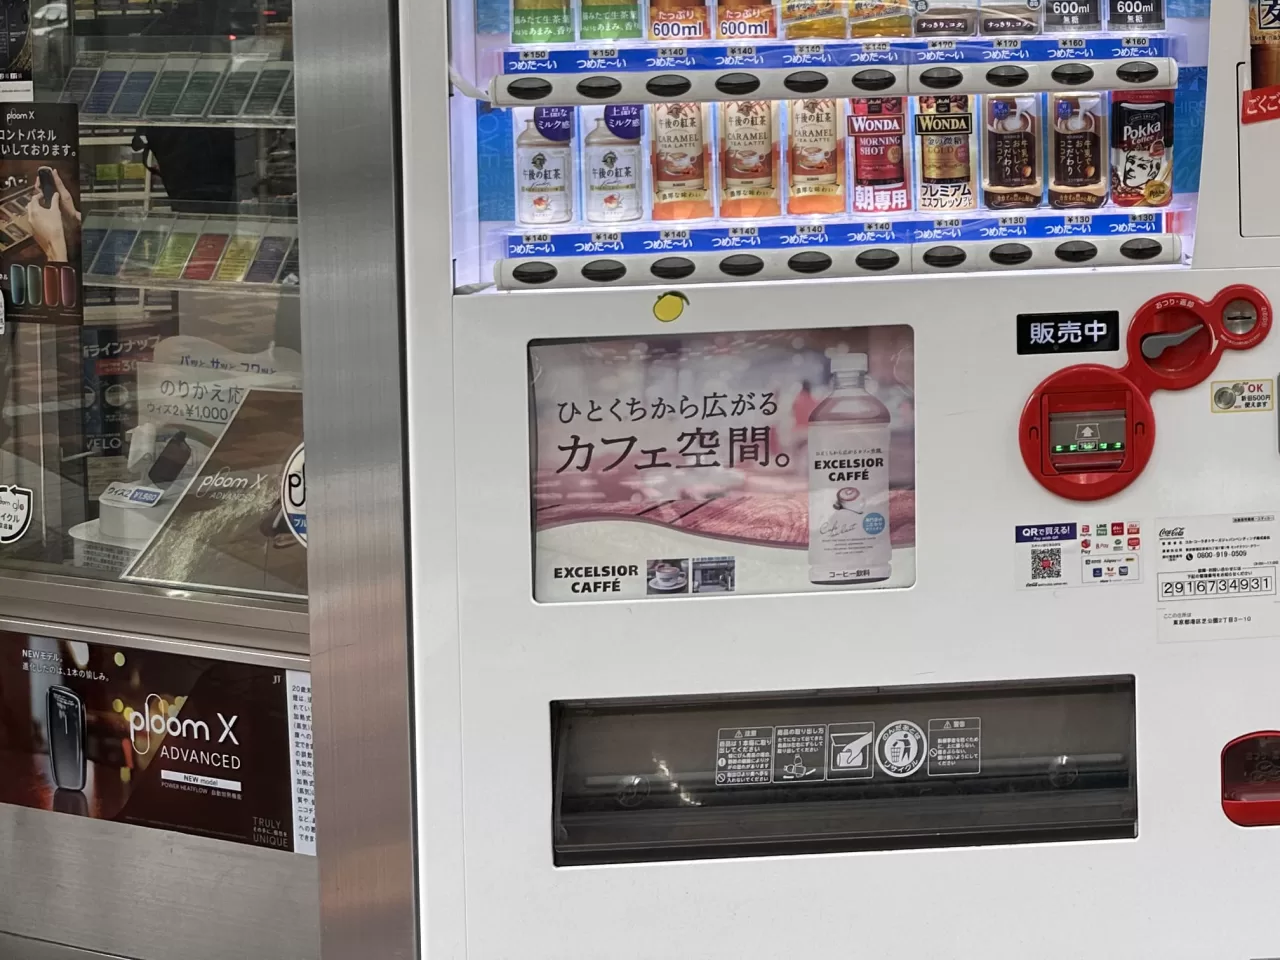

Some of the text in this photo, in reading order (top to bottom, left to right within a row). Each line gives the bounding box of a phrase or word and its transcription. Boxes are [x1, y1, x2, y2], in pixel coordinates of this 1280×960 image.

[658, 8, 694, 20] たっぷり
[725, 8, 761, 19] たっぷり
[1126, 14, 1144, 23] 無糖
[653, 21, 703, 37] 600ml
[720, 20, 769, 36] 600ml
[1125, 38, 1146, 46] ¥160
[523, 51, 546, 59] ¥150
[592, 49, 616, 57] ¥150
[540, 107, 567, 118] 上品な
[538, 119, 570, 130] ミルク感
[608, 118, 640, 129] ミルク感
[851, 116, 900, 132] WONDA
[919, 116, 968, 132] WONDA
[657, 133, 699, 143] CARAMEL
[1123, 121, 1161, 141] Pokka
[859, 136, 900, 146] MORNING
[859, 145, 884, 155] SHOT
[522, 169, 561, 181] 午後の紅茶
[922, 184, 972, 198] プレミアム
[855, 188, 907, 211] 朝専用
[921, 195, 962, 208] エスプレッソ
[1029, 320, 1108, 345] 販売中
[1247, 383, 1264, 393] OK
[557, 392, 778, 424] ひとくちから広がる
[555, 426, 791, 474] カフェ空間。
[814, 457, 884, 471] EXCELSIOR
[828, 469, 869, 482] CAFFÉ
[1022, 525, 1070, 538] QRで買える!
[553, 564, 639, 580] EXCELSIOR
[828, 569, 871, 579] コーヒー飲料
[570, 577, 621, 594] CAFFÉ
[1163, 577, 1271, 596] 2916734931
[22, 649, 64, 663] NEWモデル。
[129, 693, 240, 755] ploom X
[160, 745, 241, 770] ADVANCED
[883, 759, 919, 775] リサイクル
[183, 774, 219, 787] NEW model
[252, 816, 282, 830] TRULY
[252, 834, 289, 848] UNIQUE
